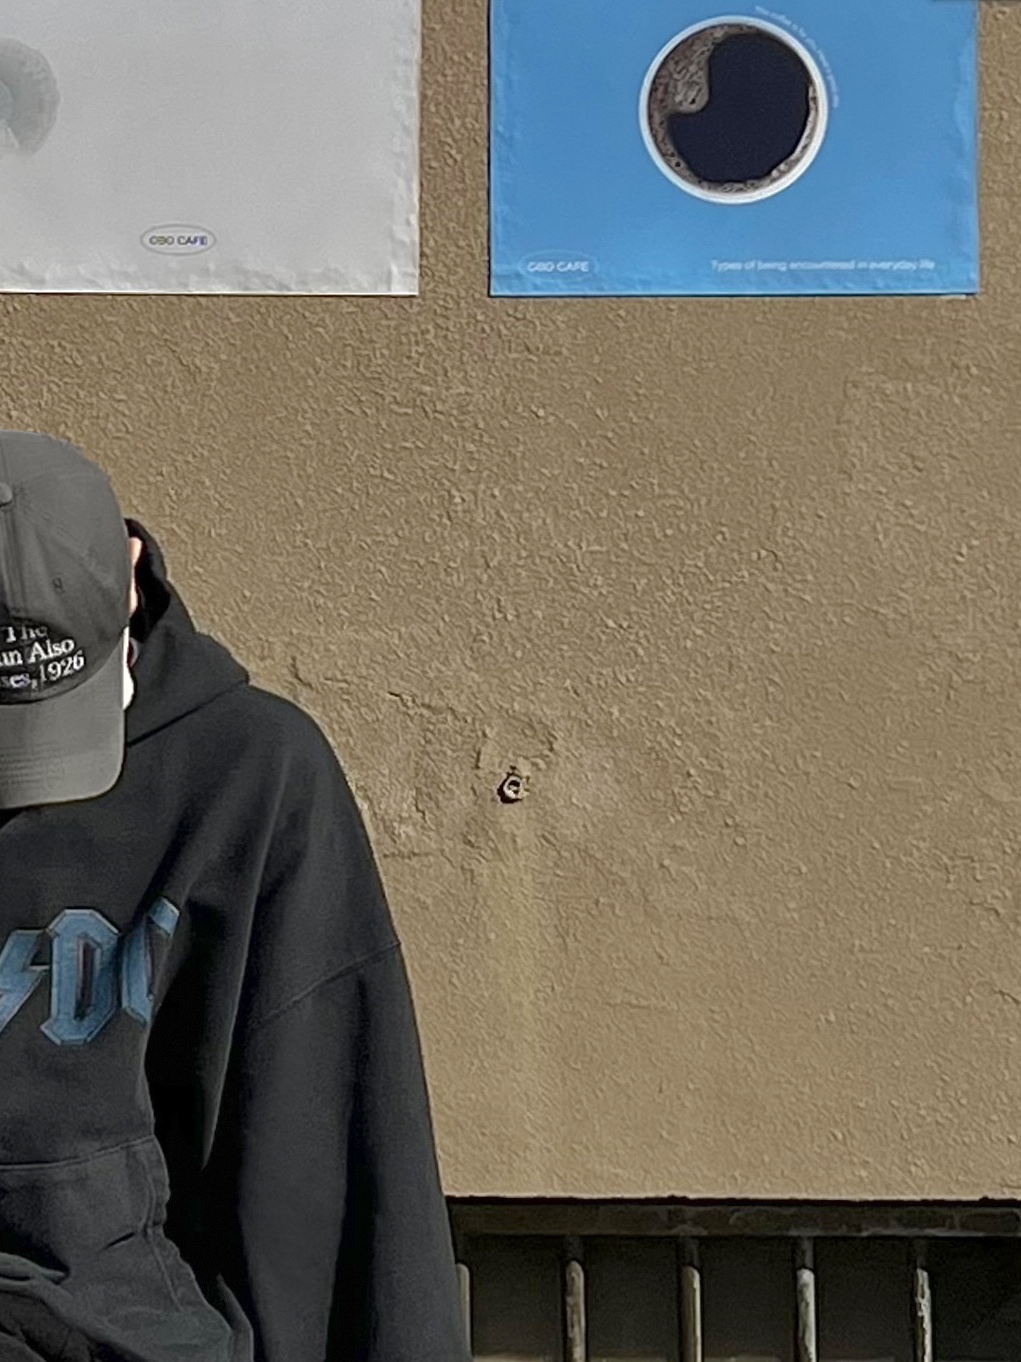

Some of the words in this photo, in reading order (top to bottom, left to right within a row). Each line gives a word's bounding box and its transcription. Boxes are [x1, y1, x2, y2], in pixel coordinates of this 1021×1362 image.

[710, 259, 742, 273] Types
[744, 259, 756, 271] of
[0, 626, 48, 643] The
[27, 638, 75, 664] Also
[39, 649, 85, 682] 1926
